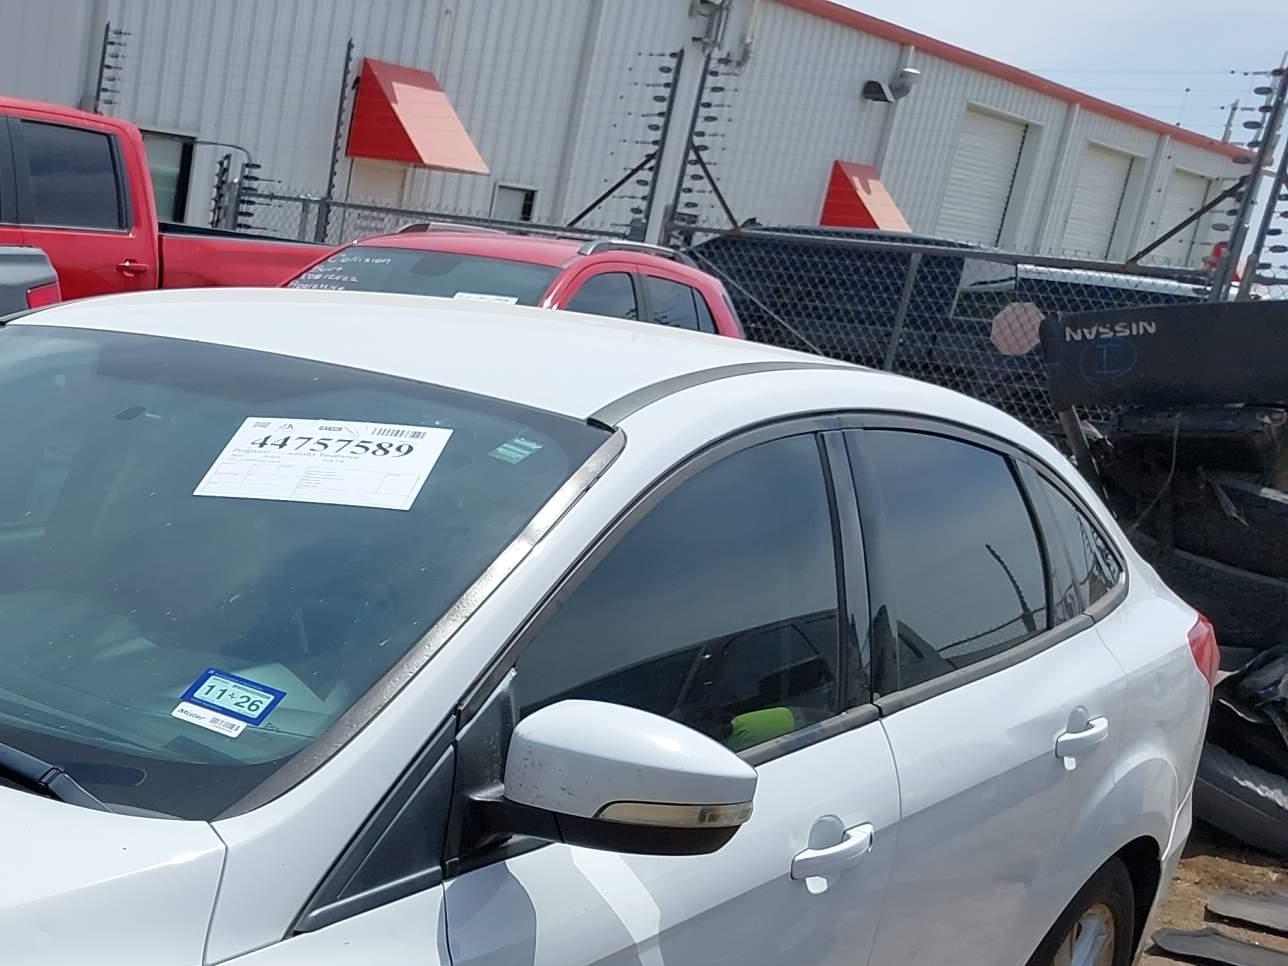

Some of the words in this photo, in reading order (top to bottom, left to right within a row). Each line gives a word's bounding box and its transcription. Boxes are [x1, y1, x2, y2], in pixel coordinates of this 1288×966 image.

[1065, 321, 1157, 342] NISSAN
[251, 434, 414, 457] 44757589
[204, 684, 228, 700] 11
[233, 695, 263, 712] 26
